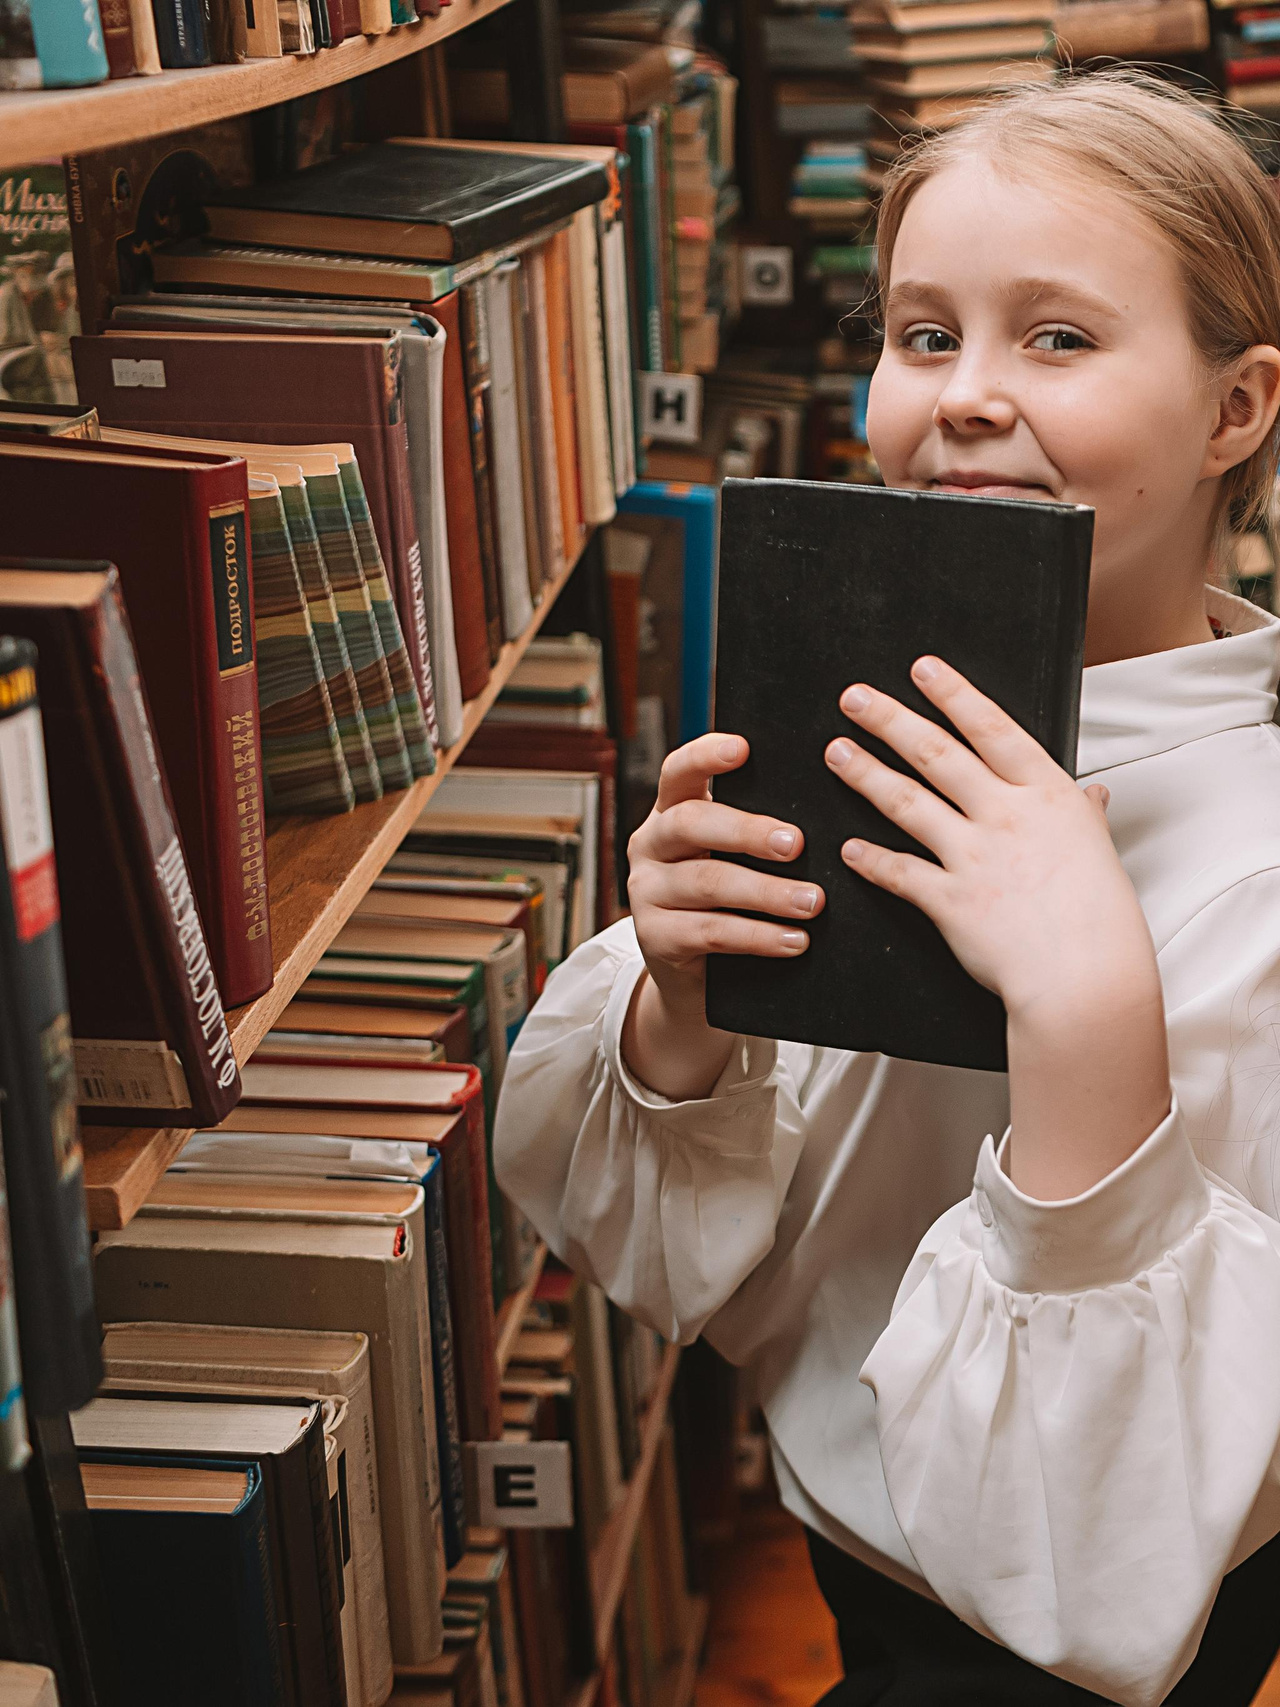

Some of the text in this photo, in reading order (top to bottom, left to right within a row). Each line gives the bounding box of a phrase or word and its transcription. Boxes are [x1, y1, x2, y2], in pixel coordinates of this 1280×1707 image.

[68, 155, 84, 223] СИВКА-БУР
[653, 386, 687, 423] Н
[222, 525, 244, 656] ПОДРОСТОК
